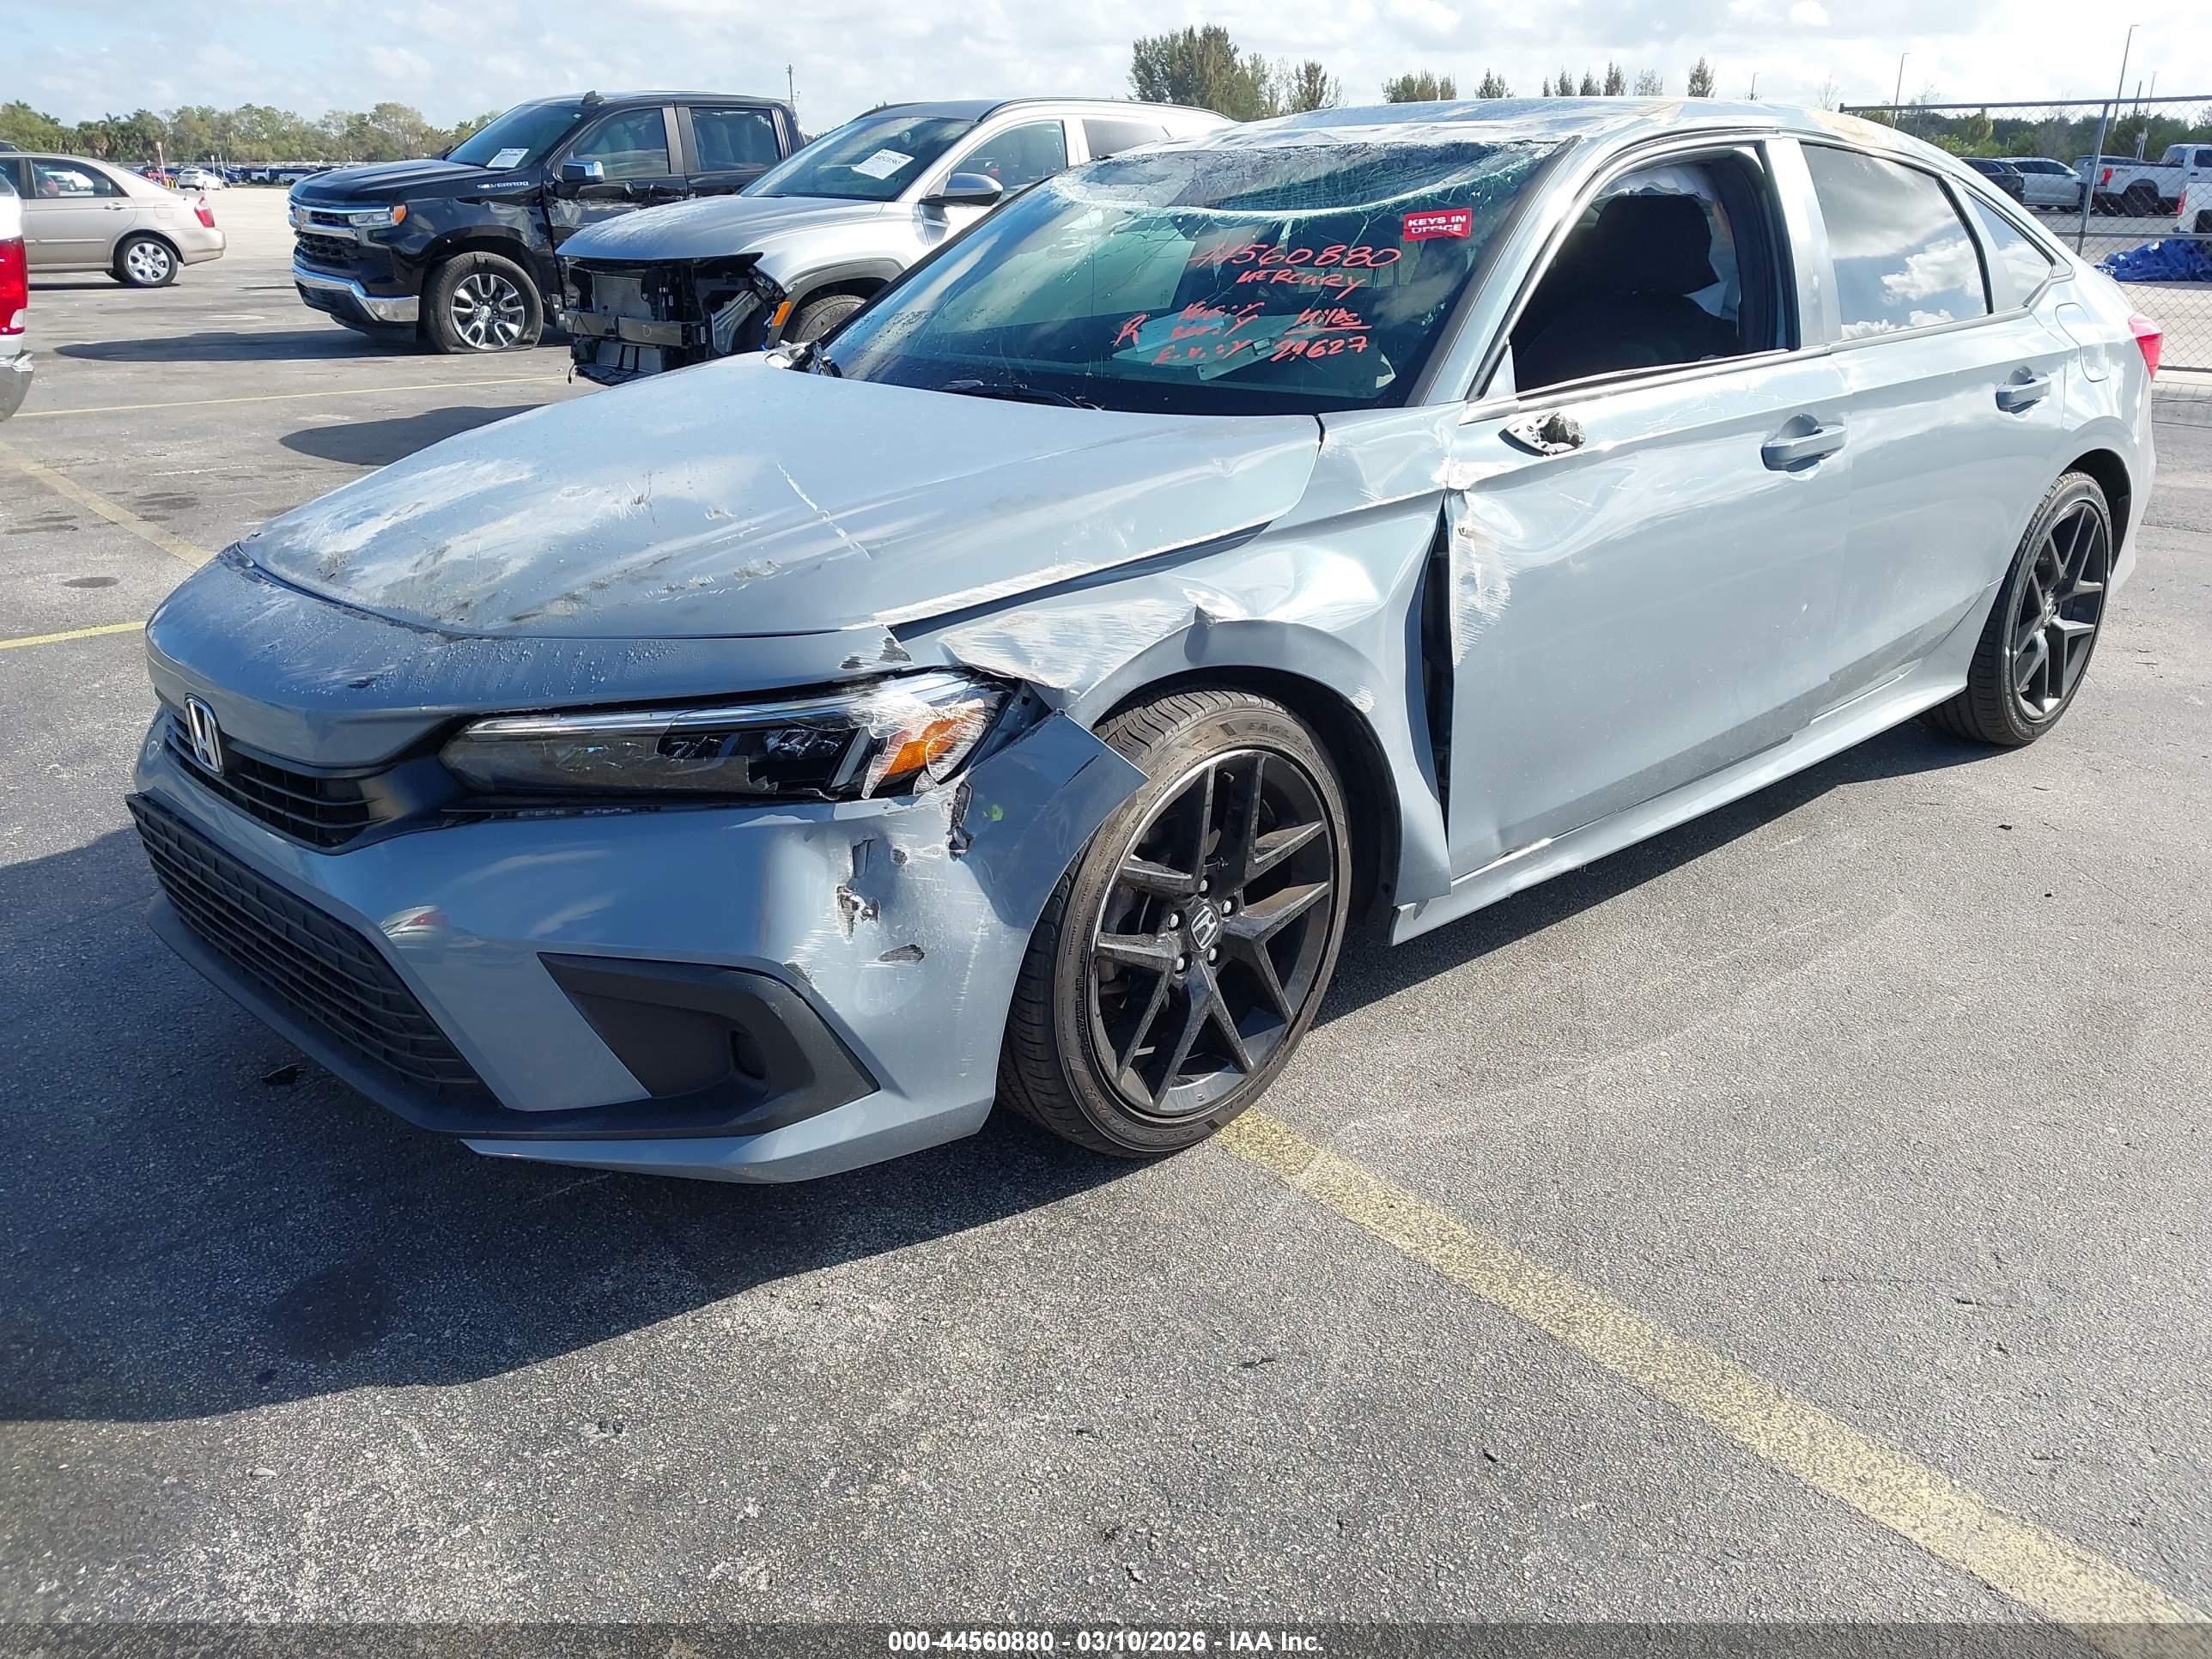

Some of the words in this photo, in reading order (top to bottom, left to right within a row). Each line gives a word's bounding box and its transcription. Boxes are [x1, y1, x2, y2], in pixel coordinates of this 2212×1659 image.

[477, 180, 530, 189] SILVERADO
[1407, 216, 1447, 227] KEYS
[1450, 215, 1467, 223] IN
